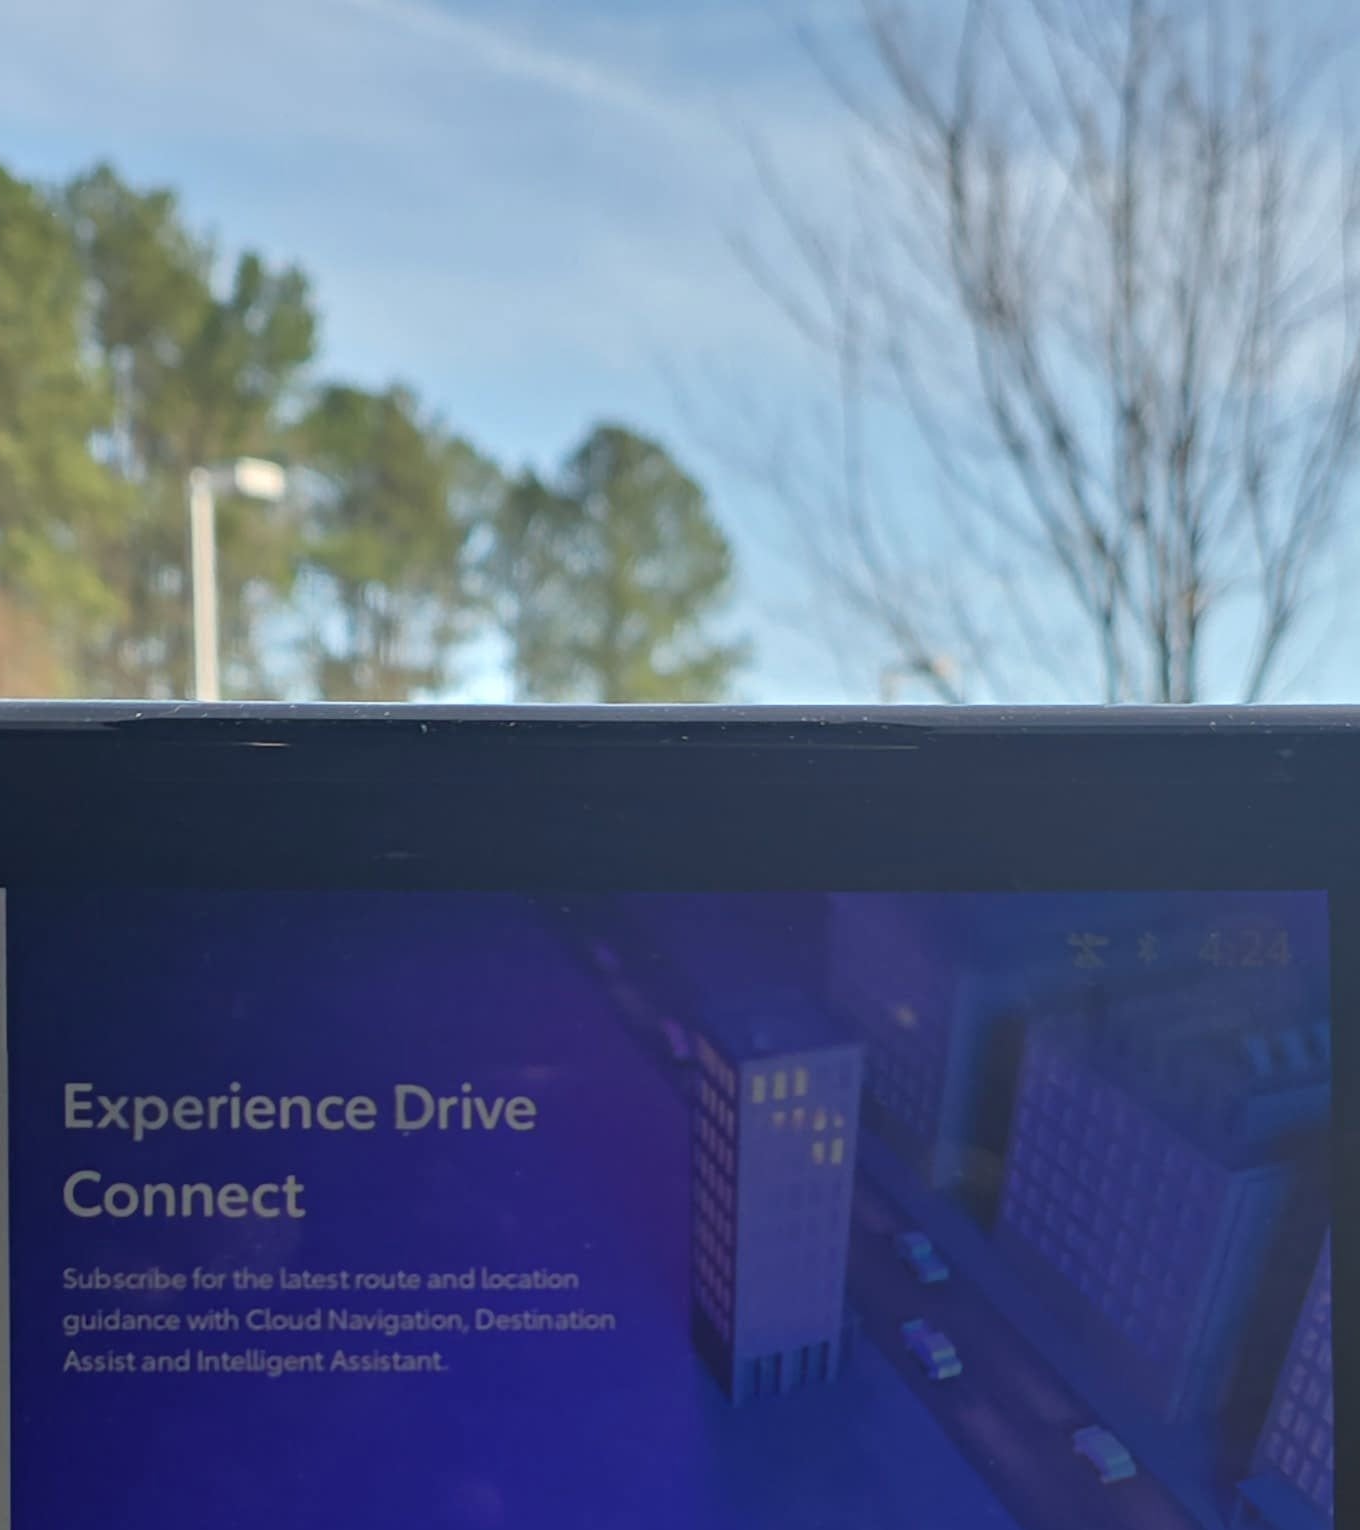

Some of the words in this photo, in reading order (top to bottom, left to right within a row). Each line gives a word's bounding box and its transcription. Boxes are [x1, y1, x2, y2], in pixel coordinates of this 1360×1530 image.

[1197, 930, 1292, 968] 4:24
[63, 1082, 378, 1141] Experience
[394, 1082, 537, 1131] Drive
[62, 1169, 306, 1219] Connect
[62, 1266, 187, 1291] Subscribe
[191, 1266, 227, 1290] for
[232, 1266, 274, 1290] the
[279, 1266, 351, 1291] latest
[354, 1269, 422, 1290] route
[426, 1266, 476, 1290] and
[481, 1266, 580, 1290] location
[62, 1308, 181, 1336] guidance
[186, 1307, 240, 1331] with
[245, 1307, 322, 1331] Cloud
[327, 1308, 470, 1336] Navigation,
[475, 1307, 616, 1331] Destination
[62, 1348, 137, 1373] Assist
[140, 1348, 191, 1372] and
[197, 1348, 325, 1378] Intelligent
[329, 1348, 449, 1372] Assistant.
